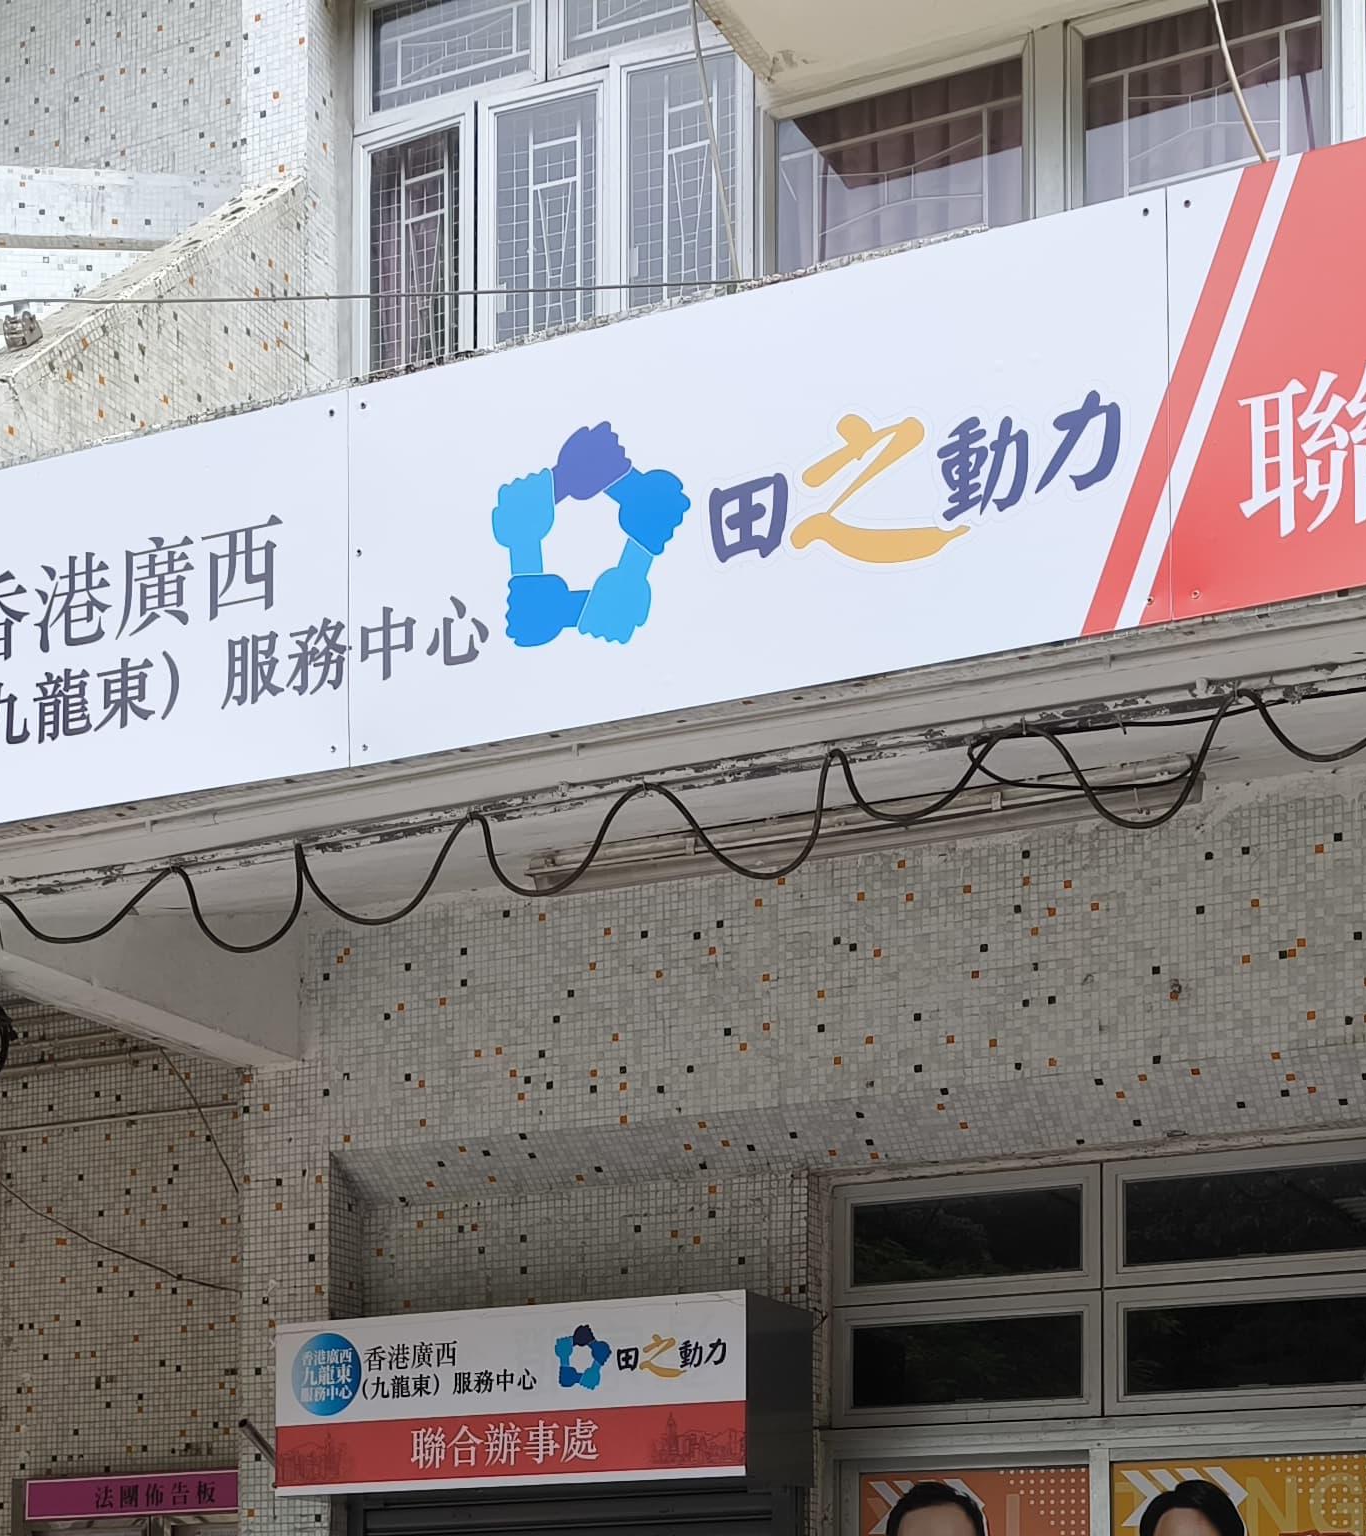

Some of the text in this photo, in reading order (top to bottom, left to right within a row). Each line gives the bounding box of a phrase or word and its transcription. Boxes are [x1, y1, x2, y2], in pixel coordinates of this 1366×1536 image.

[709, 389, 1121, 563] 田之動力
[302, 1363, 352, 1387] 九龍東
[364, 1341, 458, 1371] 香港廣西
[616, 1333, 728, 1380] 田之動力
[410, 1418, 600, 1471] 聯合辦事處
[94, 1481, 216, 1509] 法團佈告板
